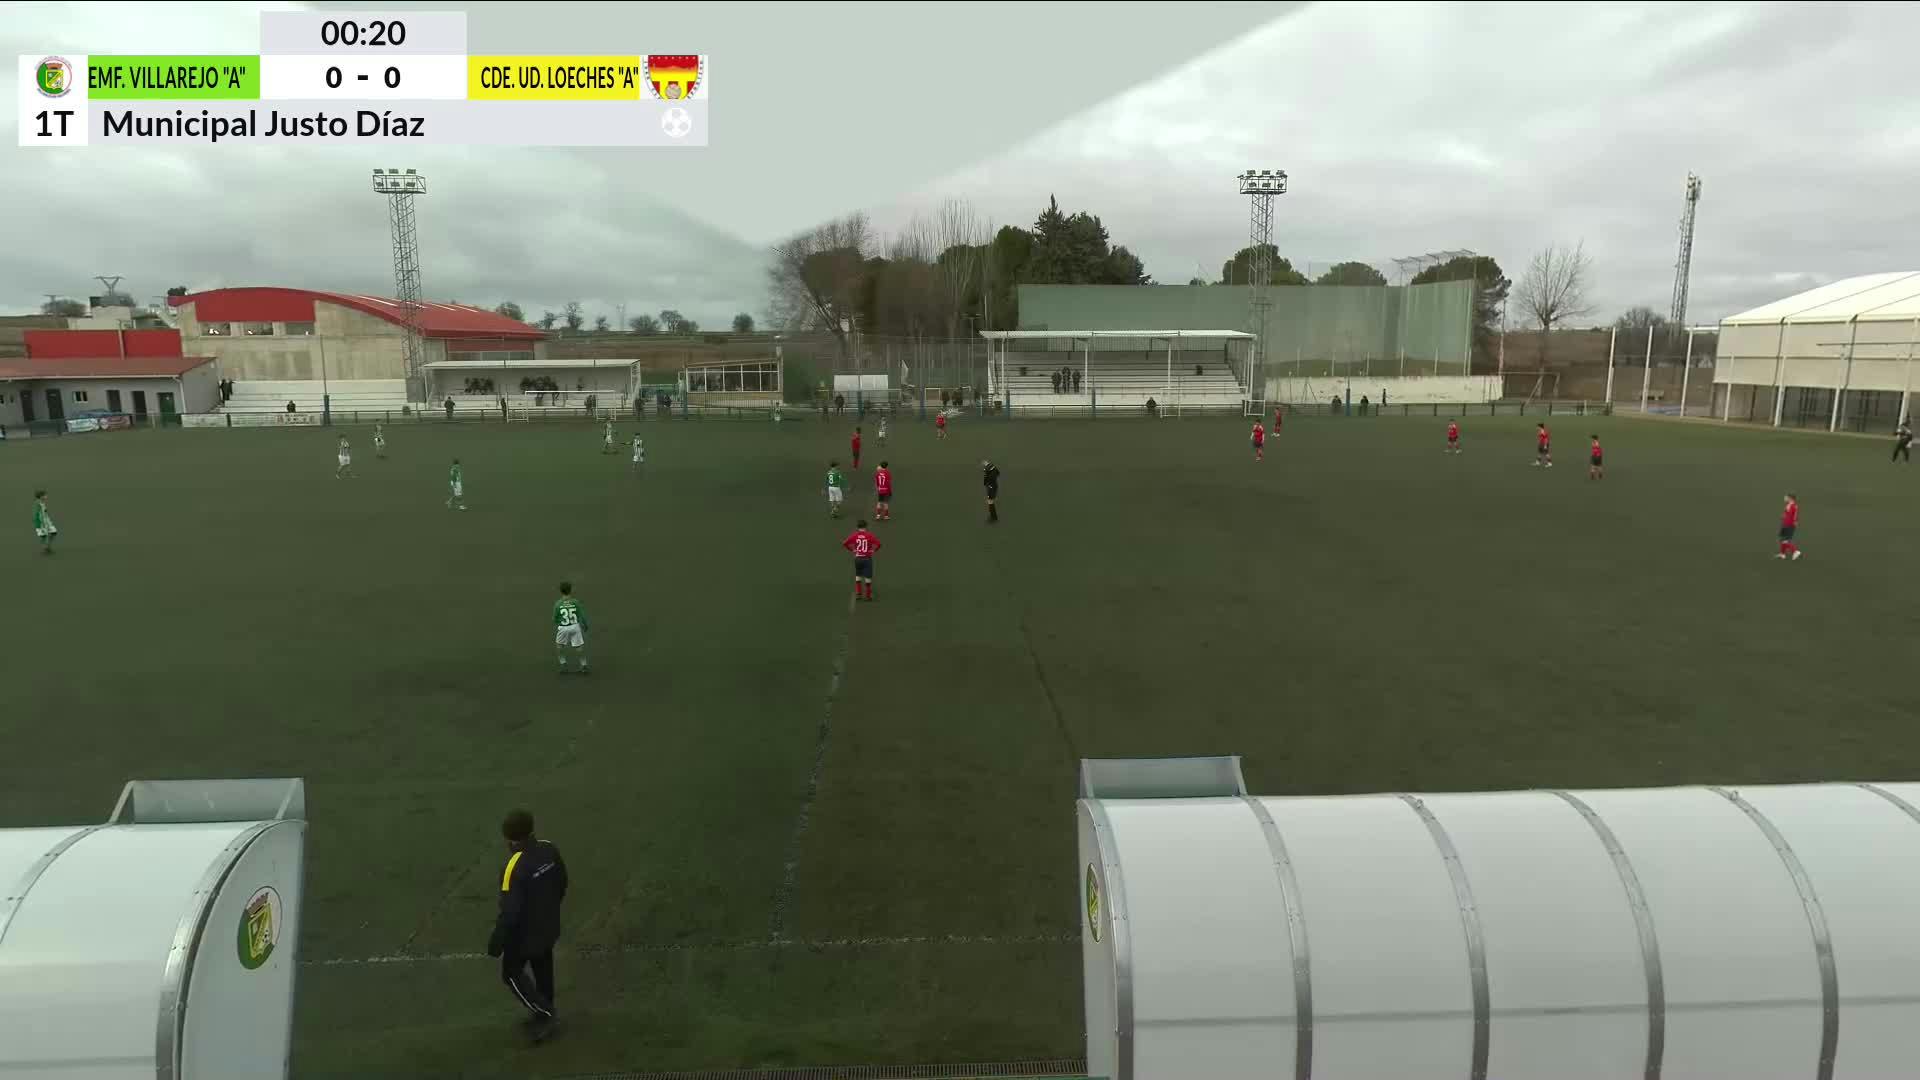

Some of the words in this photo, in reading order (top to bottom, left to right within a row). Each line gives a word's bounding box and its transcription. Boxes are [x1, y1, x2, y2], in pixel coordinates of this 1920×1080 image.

[878, 475, 886, 486] 17
[856, 538, 868, 553] 20
[559, 607, 578, 626] 35
